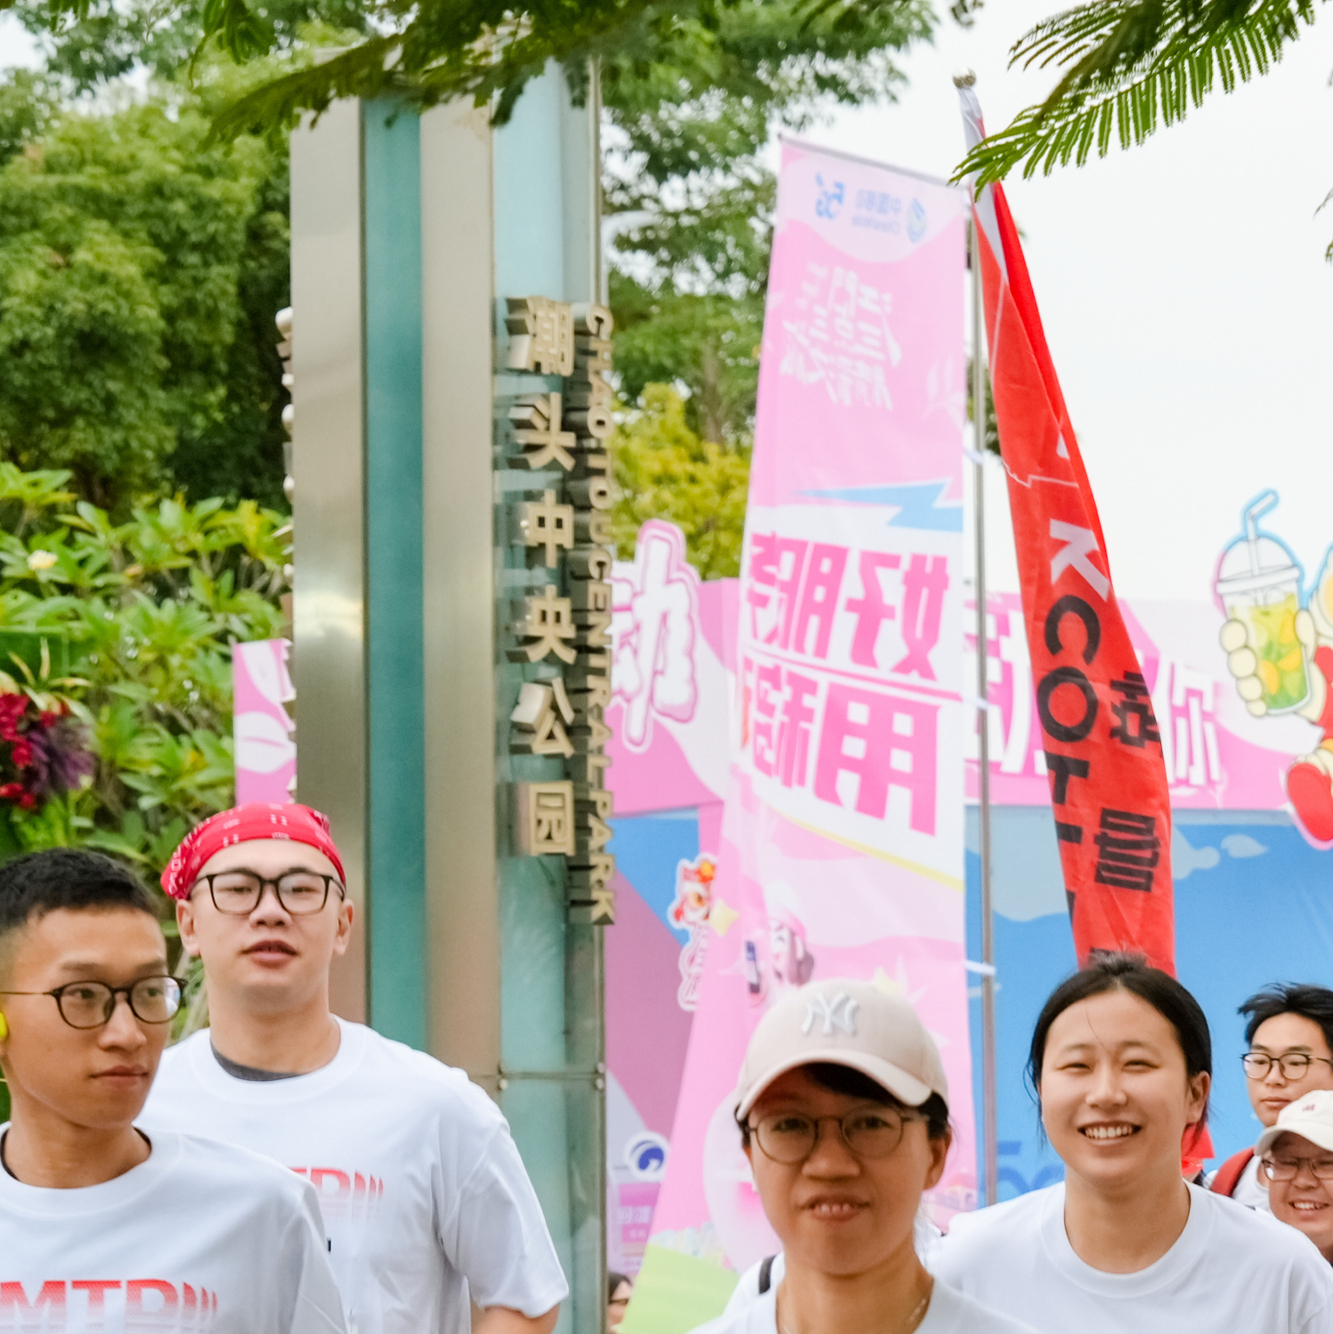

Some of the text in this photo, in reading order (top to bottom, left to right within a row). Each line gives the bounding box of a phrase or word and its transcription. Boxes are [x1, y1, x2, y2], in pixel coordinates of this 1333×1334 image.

[508, 294, 577, 858] 潮头中央公园
